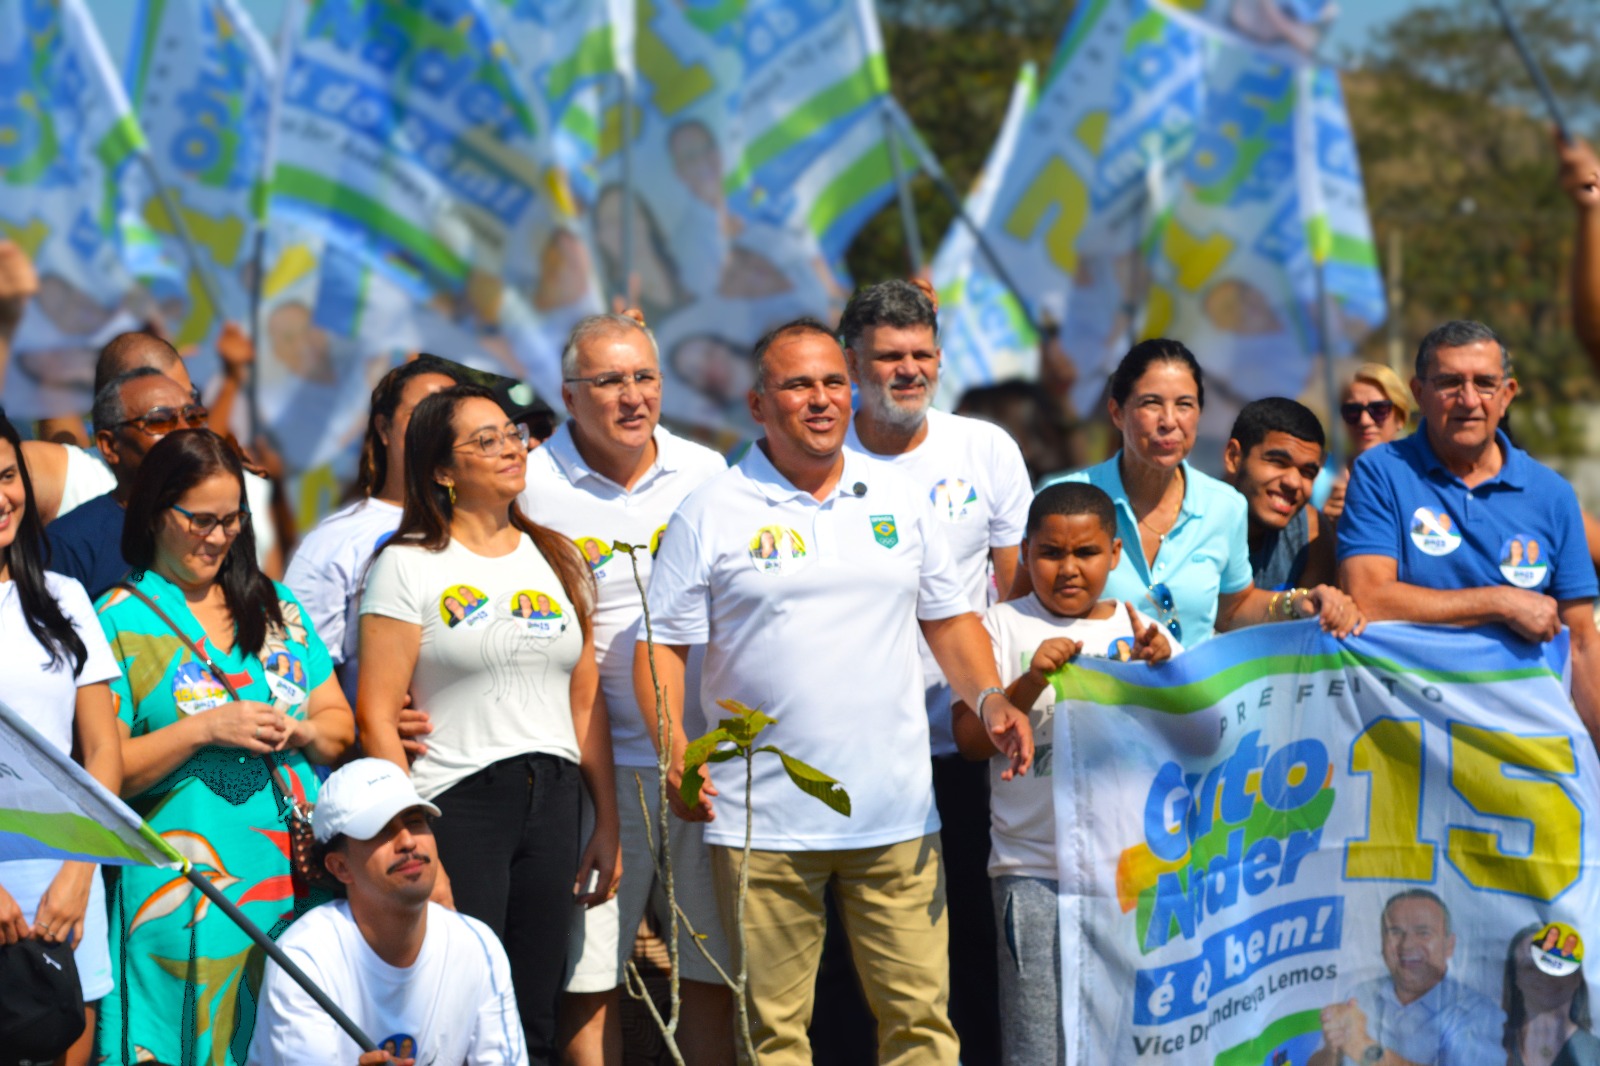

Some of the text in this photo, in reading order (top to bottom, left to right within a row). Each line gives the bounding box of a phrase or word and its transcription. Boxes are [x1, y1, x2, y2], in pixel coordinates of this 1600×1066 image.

[1219, 676, 1443, 739] PREFEITO
[1342, 714, 1584, 905] 15
[1132, 1032, 1186, 1057] Vice
[1268, 963, 1338, 996] Lemos
[1147, 970, 1176, 1017] é
[1225, 904, 1334, 980] bem!
